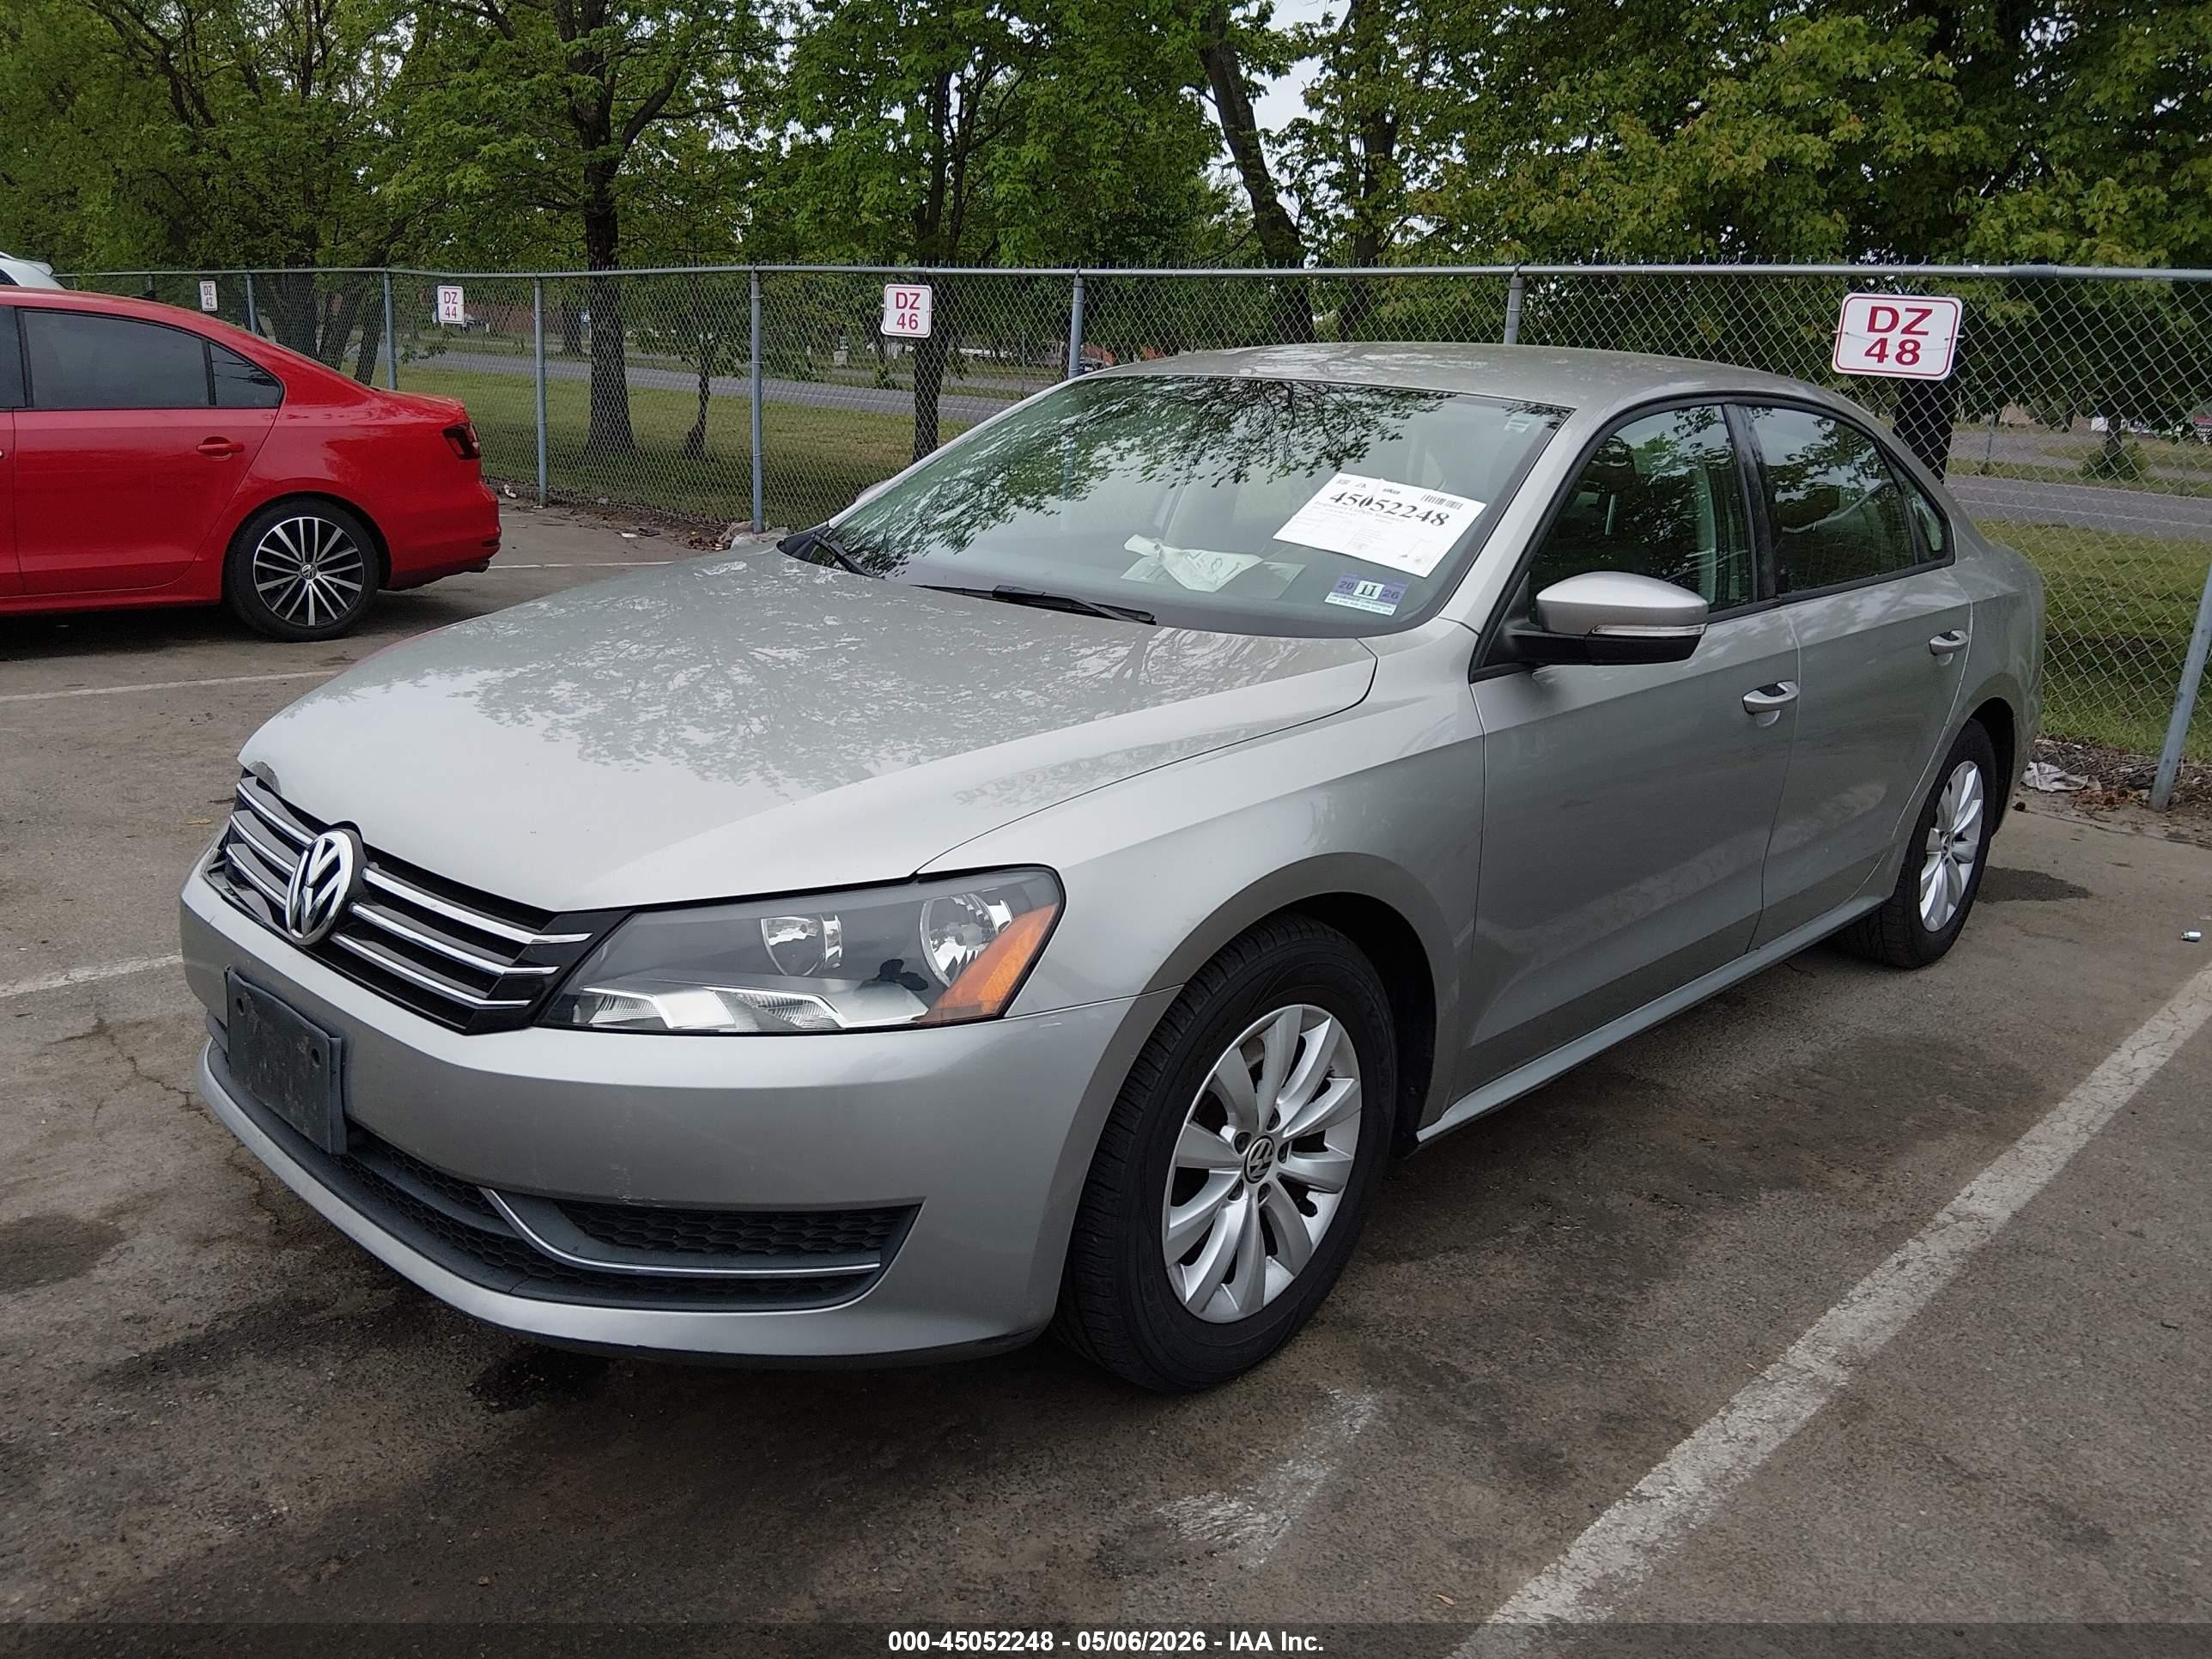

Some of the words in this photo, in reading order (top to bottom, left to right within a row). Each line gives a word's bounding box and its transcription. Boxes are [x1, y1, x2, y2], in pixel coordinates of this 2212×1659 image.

[204, 285, 213, 295] DZ
[444, 291, 458, 304] DZ
[896, 292, 921, 310] DZ
[445, 306, 458, 319] 44
[1867, 306, 1933, 336] DZ
[896, 313, 919, 331] 46
[1864, 337, 1921, 366] 48
[1329, 490, 1450, 527] 45052248
[1338, 580, 1354, 591] 20
[1358, 584, 1377, 597] 11
